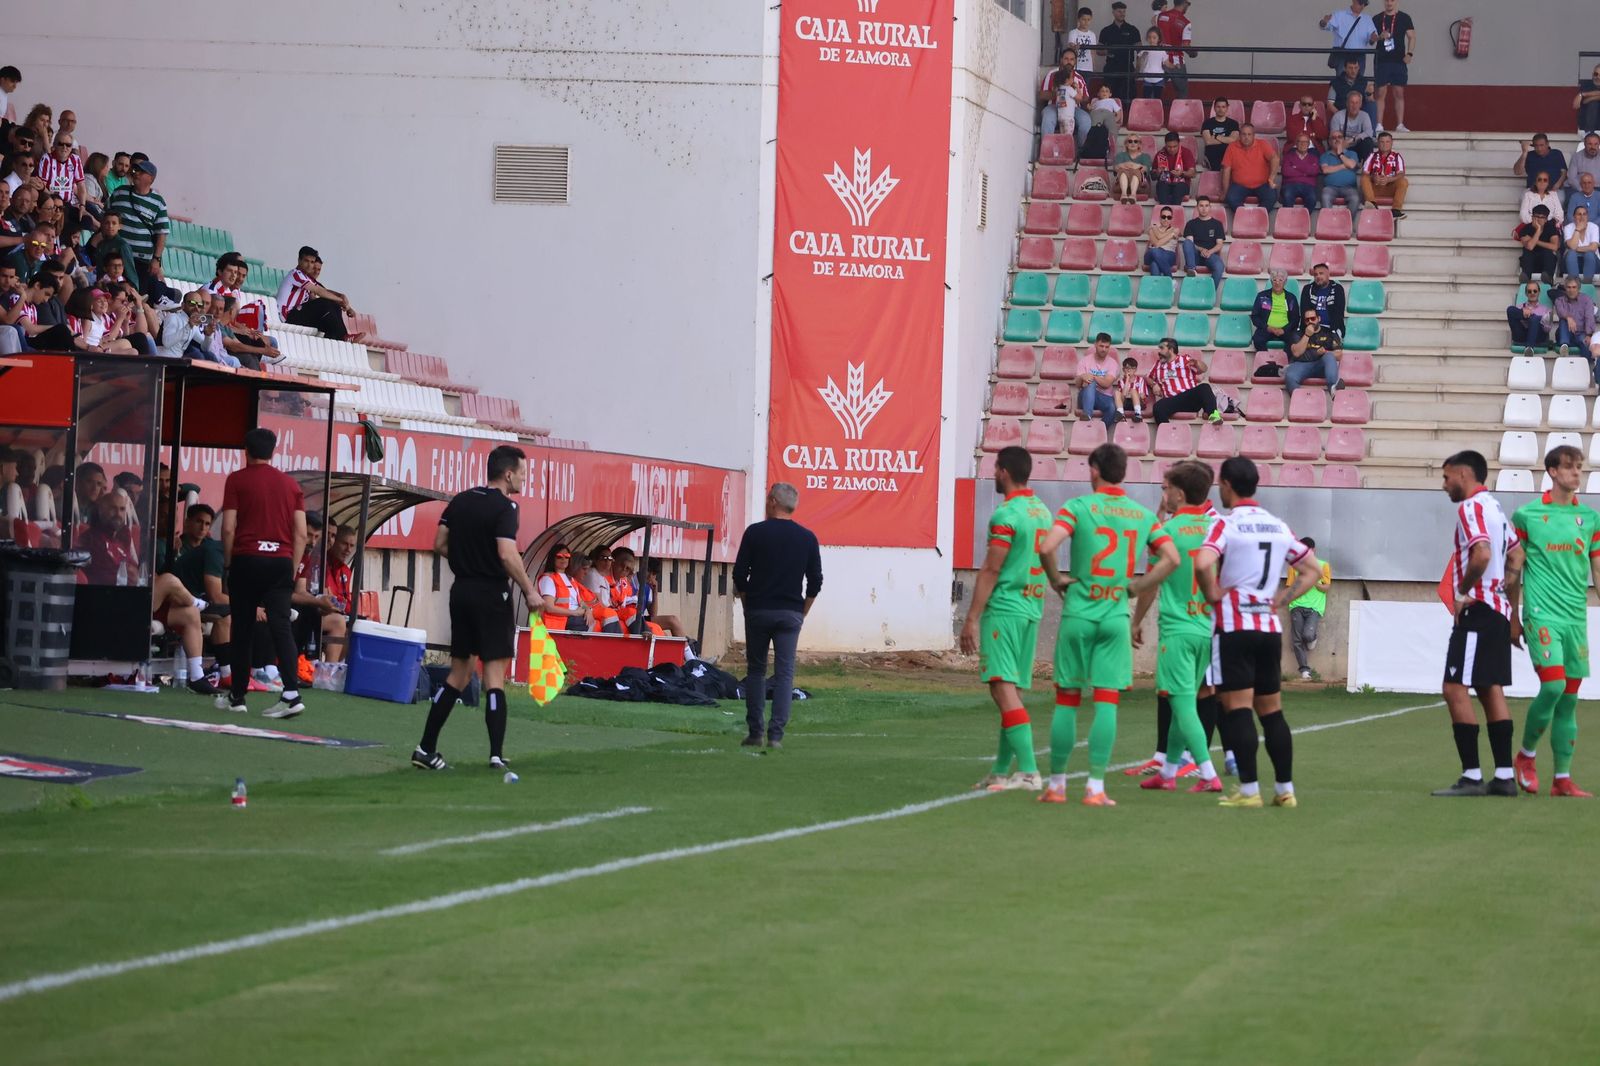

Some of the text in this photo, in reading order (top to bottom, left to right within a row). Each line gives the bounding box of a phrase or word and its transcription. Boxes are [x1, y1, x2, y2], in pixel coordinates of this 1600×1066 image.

[795, 16, 938, 49] CAJA RURAL
[819, 47, 911, 67] DE ZAMORA
[789, 230, 931, 262] CAJA RURAL
[812, 261, 905, 280] DE ZAMORA
[782, 444, 924, 473] CAJA RURAL
[430, 448, 490, 495] FABRICA
[540, 459, 576, 503] STAND
[806, 475, 898, 492] DE ZAMORA
[1090, 526, 1138, 578] 21
[1256, 541, 1272, 590] 7
[1538, 626, 1552, 646] 8
